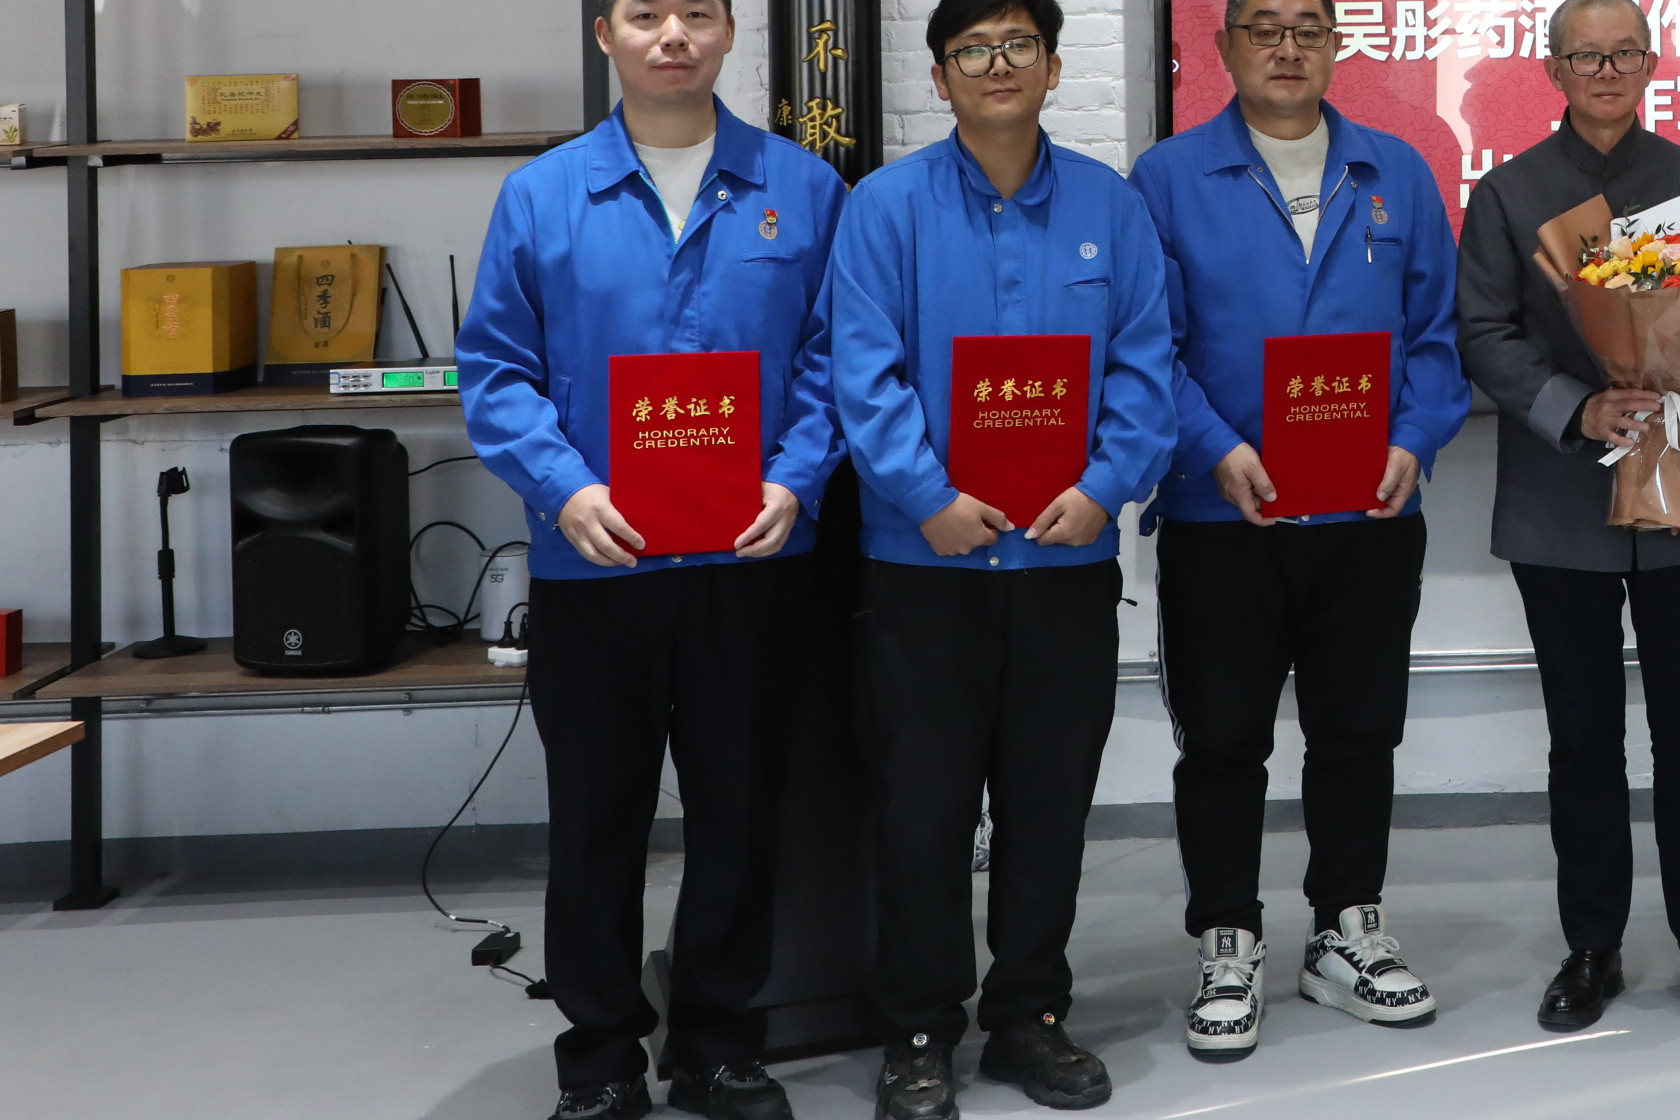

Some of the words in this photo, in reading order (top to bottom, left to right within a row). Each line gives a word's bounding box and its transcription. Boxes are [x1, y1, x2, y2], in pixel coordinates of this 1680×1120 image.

[313, 274, 336, 329] 四季酒
[973, 377, 1068, 403] 荣誉证书
[1286, 374, 1372, 398] 荣誉证书
[632, 395, 736, 422] 荣誉证书
[978, 408, 1061, 420] HONORARY
[1291, 402, 1366, 414] HONORARY
[1286, 410, 1370, 422] CREDENTIAL
[973, 417, 1066, 429] CREDENTIAL
[638, 427, 730, 439] HONORARY
[633, 436, 736, 449] CREDENTIAL
